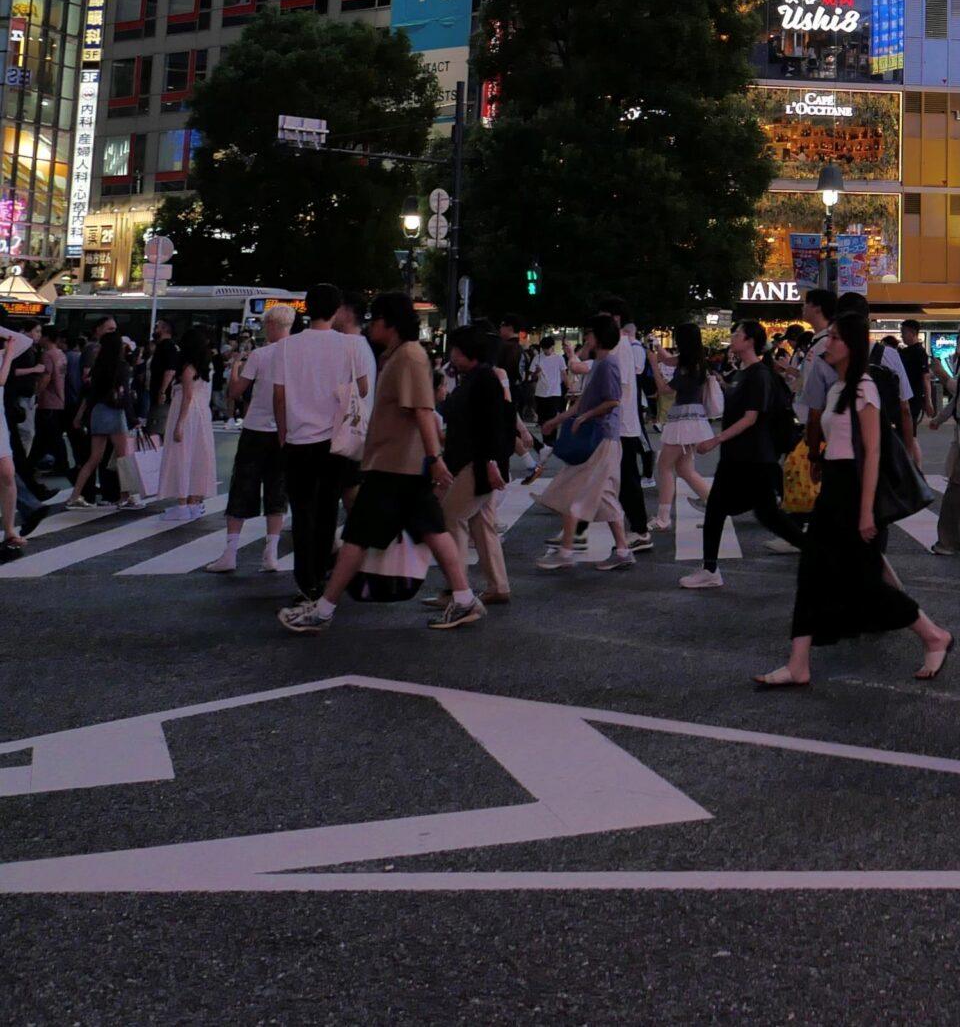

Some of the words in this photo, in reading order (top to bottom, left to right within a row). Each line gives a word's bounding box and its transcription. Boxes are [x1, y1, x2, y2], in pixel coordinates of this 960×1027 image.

[777, 5, 861, 32] Ushi8
[84, 50, 99, 60] 5F
[82, 72, 99, 83] 3F
[80, 104, 94, 128] 内科
[75, 134, 92, 183] 産婦人科
